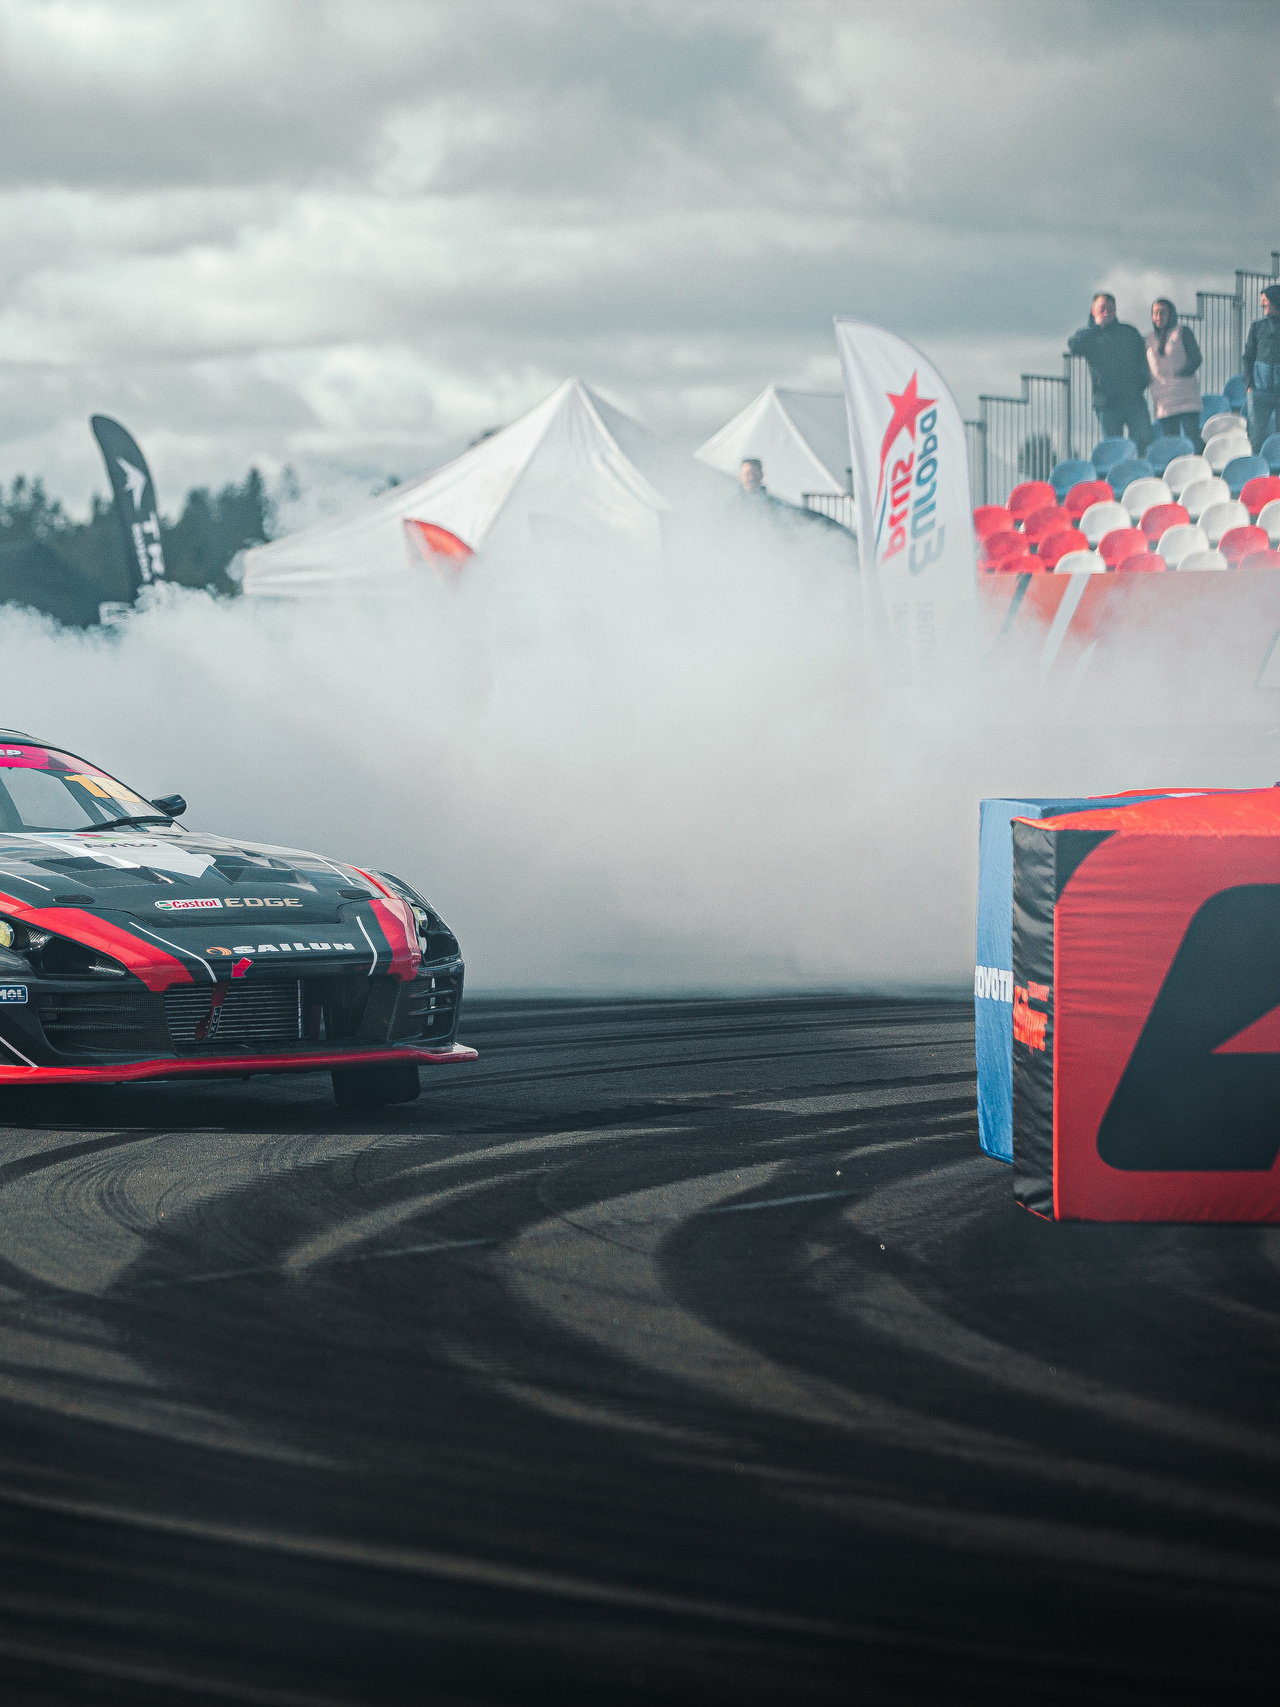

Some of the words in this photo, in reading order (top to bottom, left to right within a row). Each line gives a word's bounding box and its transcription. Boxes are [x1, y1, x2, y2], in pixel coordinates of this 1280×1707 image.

[172, 898, 218, 909] Castrol
[224, 897, 304, 908] EDGE
[232, 942, 356, 954] SAILUN
